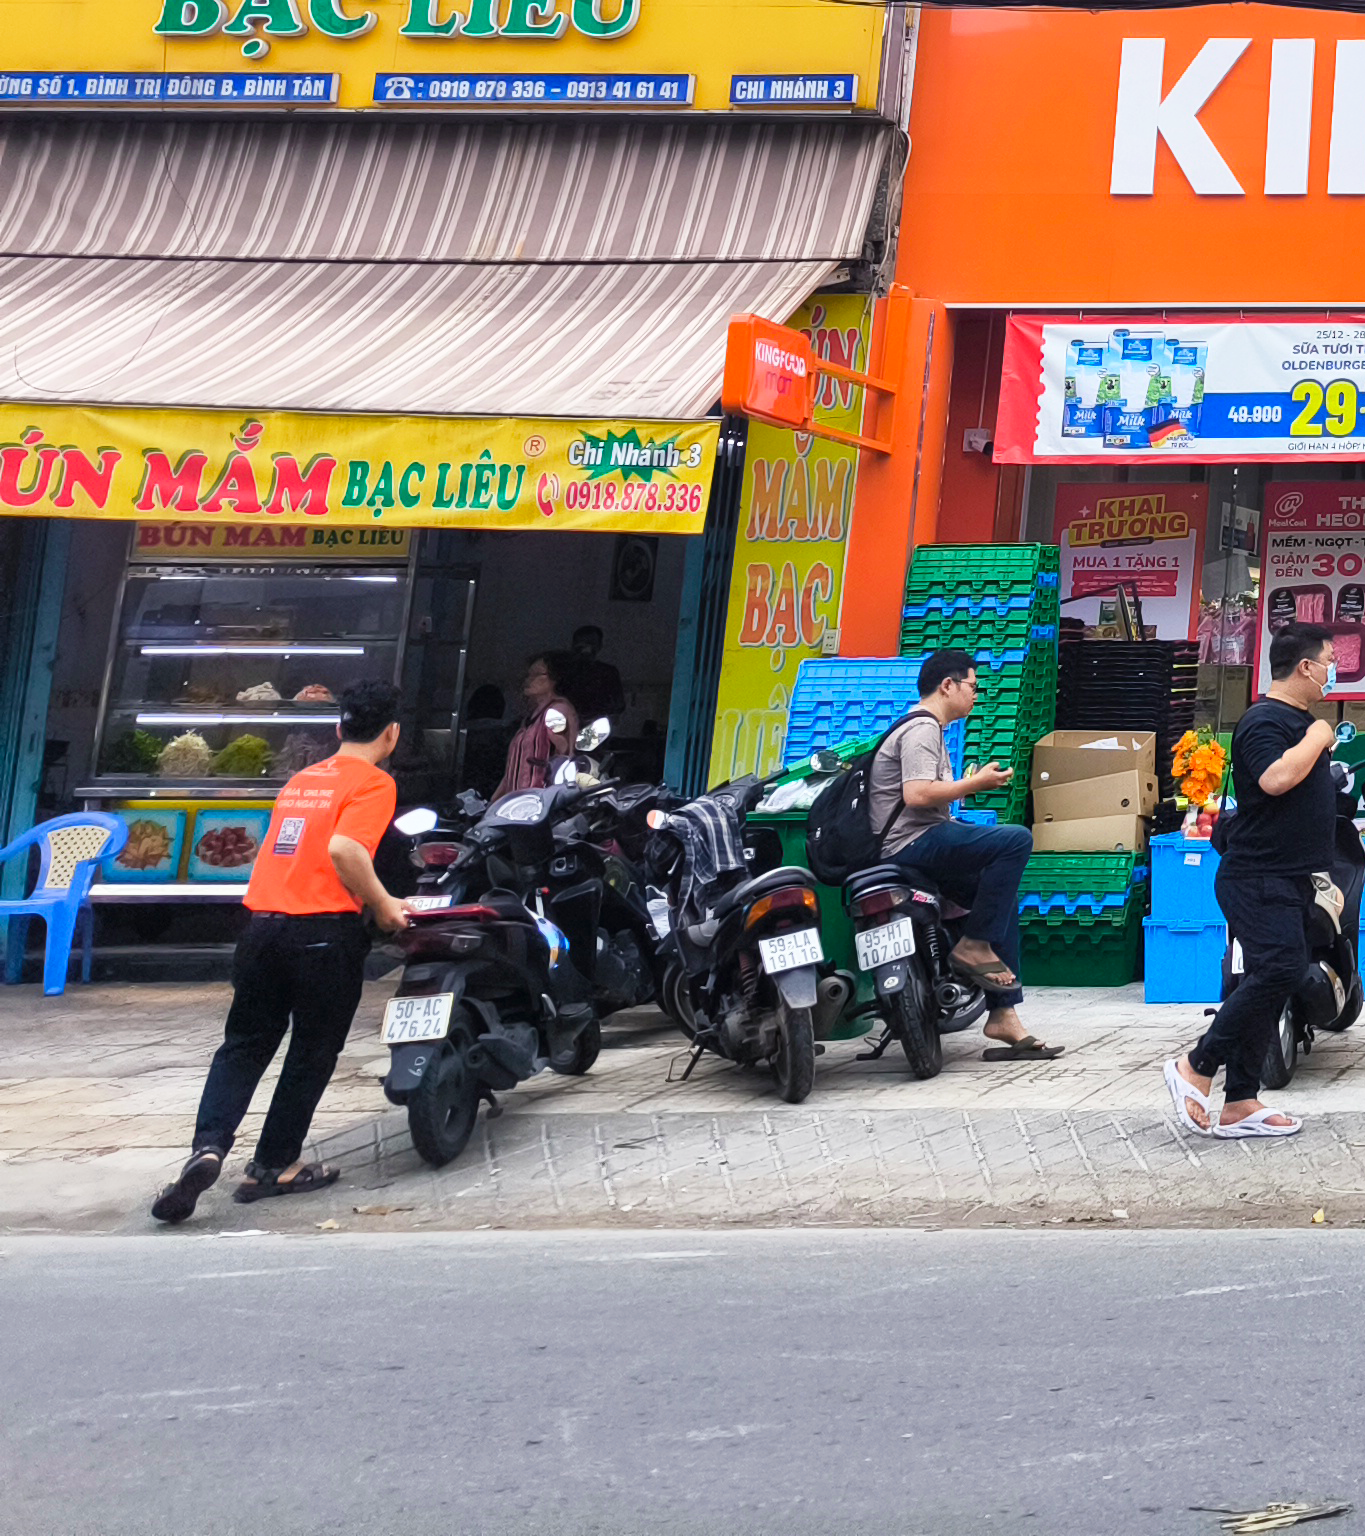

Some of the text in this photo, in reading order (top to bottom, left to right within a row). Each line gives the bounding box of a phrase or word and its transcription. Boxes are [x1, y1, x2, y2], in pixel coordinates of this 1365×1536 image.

[37, 73, 326, 99] SỐ BÌNH TRỊ ĐÔNG BÌNH TÂN
[429, 80, 679, 100] 0918 878 336 0913 41 61 41
[735, 74, 846, 100] CHI NHÁNH 3
[1292, 342, 1320, 355] SỮA
[567, 436, 702, 468] Chi Nhánh 3
[133, 417, 527, 518] MẮM BẠC LIÊU
[564, 481, 703, 514] 0918.878.336
[1099, 495, 1165, 519] KHAI
[1069, 514, 1188, 544] TRƯƠNG
[1316, 513, 1362, 528] HEO
[311, 528, 354, 549] BẠC
[1314, 537, 1354, 550] NGỌT
[1072, 554, 1168, 572] MUA TẶNG
[1270, 551, 1310, 565] GIẢM
[1274, 565, 1304, 578] ĐẾN
[738, 561, 833, 673] BẠC
[862, 938, 912, 968] 107.00
[395, 997, 443, 1020] 50-AC
[387, 1017, 442, 1041] 476.24
